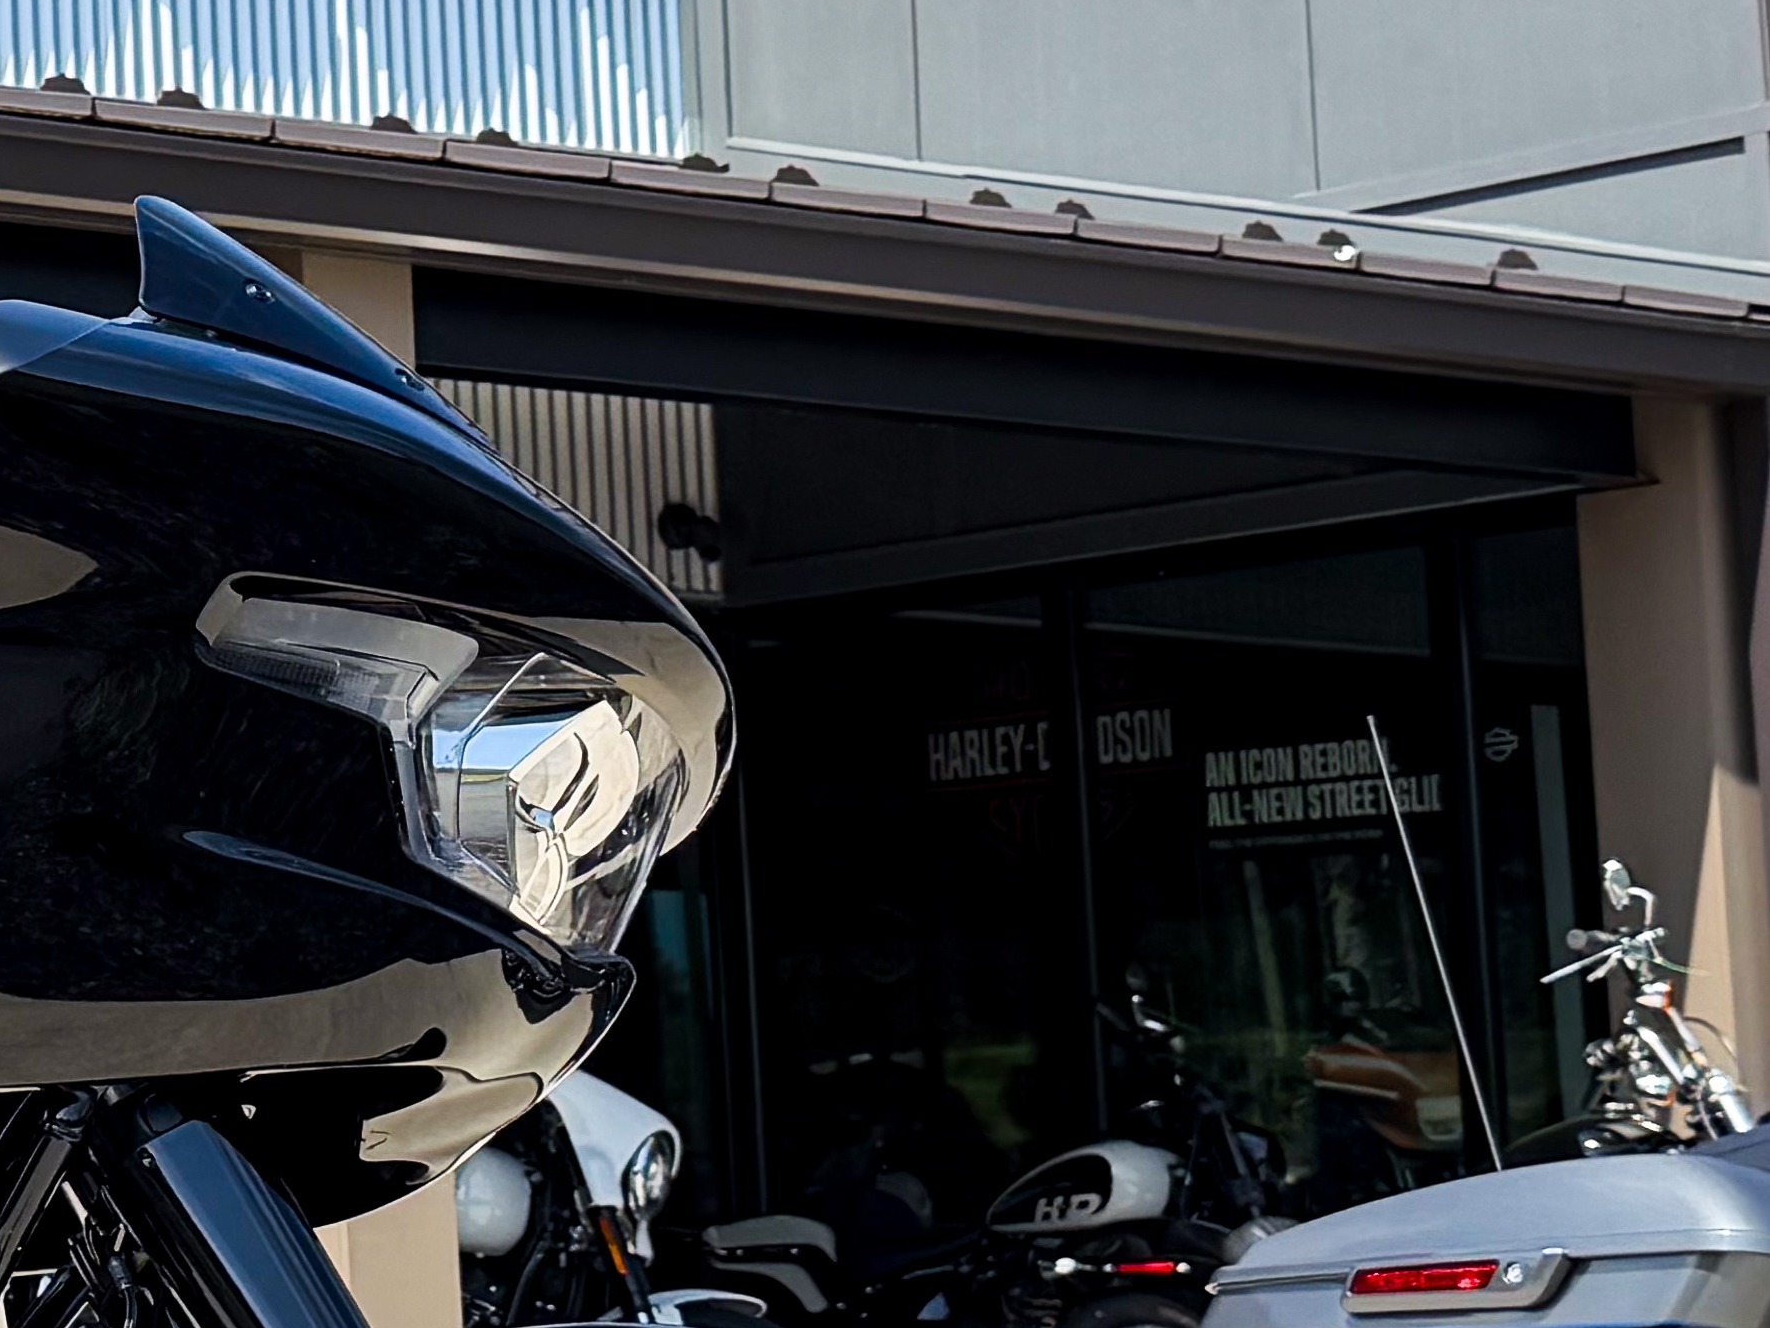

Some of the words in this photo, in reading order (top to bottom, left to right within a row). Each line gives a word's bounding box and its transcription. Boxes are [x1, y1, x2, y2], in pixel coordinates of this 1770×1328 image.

[1205, 751, 1235, 787] AN
[1240, 746, 1294, 784] ICON
[1207, 786, 1304, 827] ALL-NEW
[1307, 778, 1388, 820] STREET
